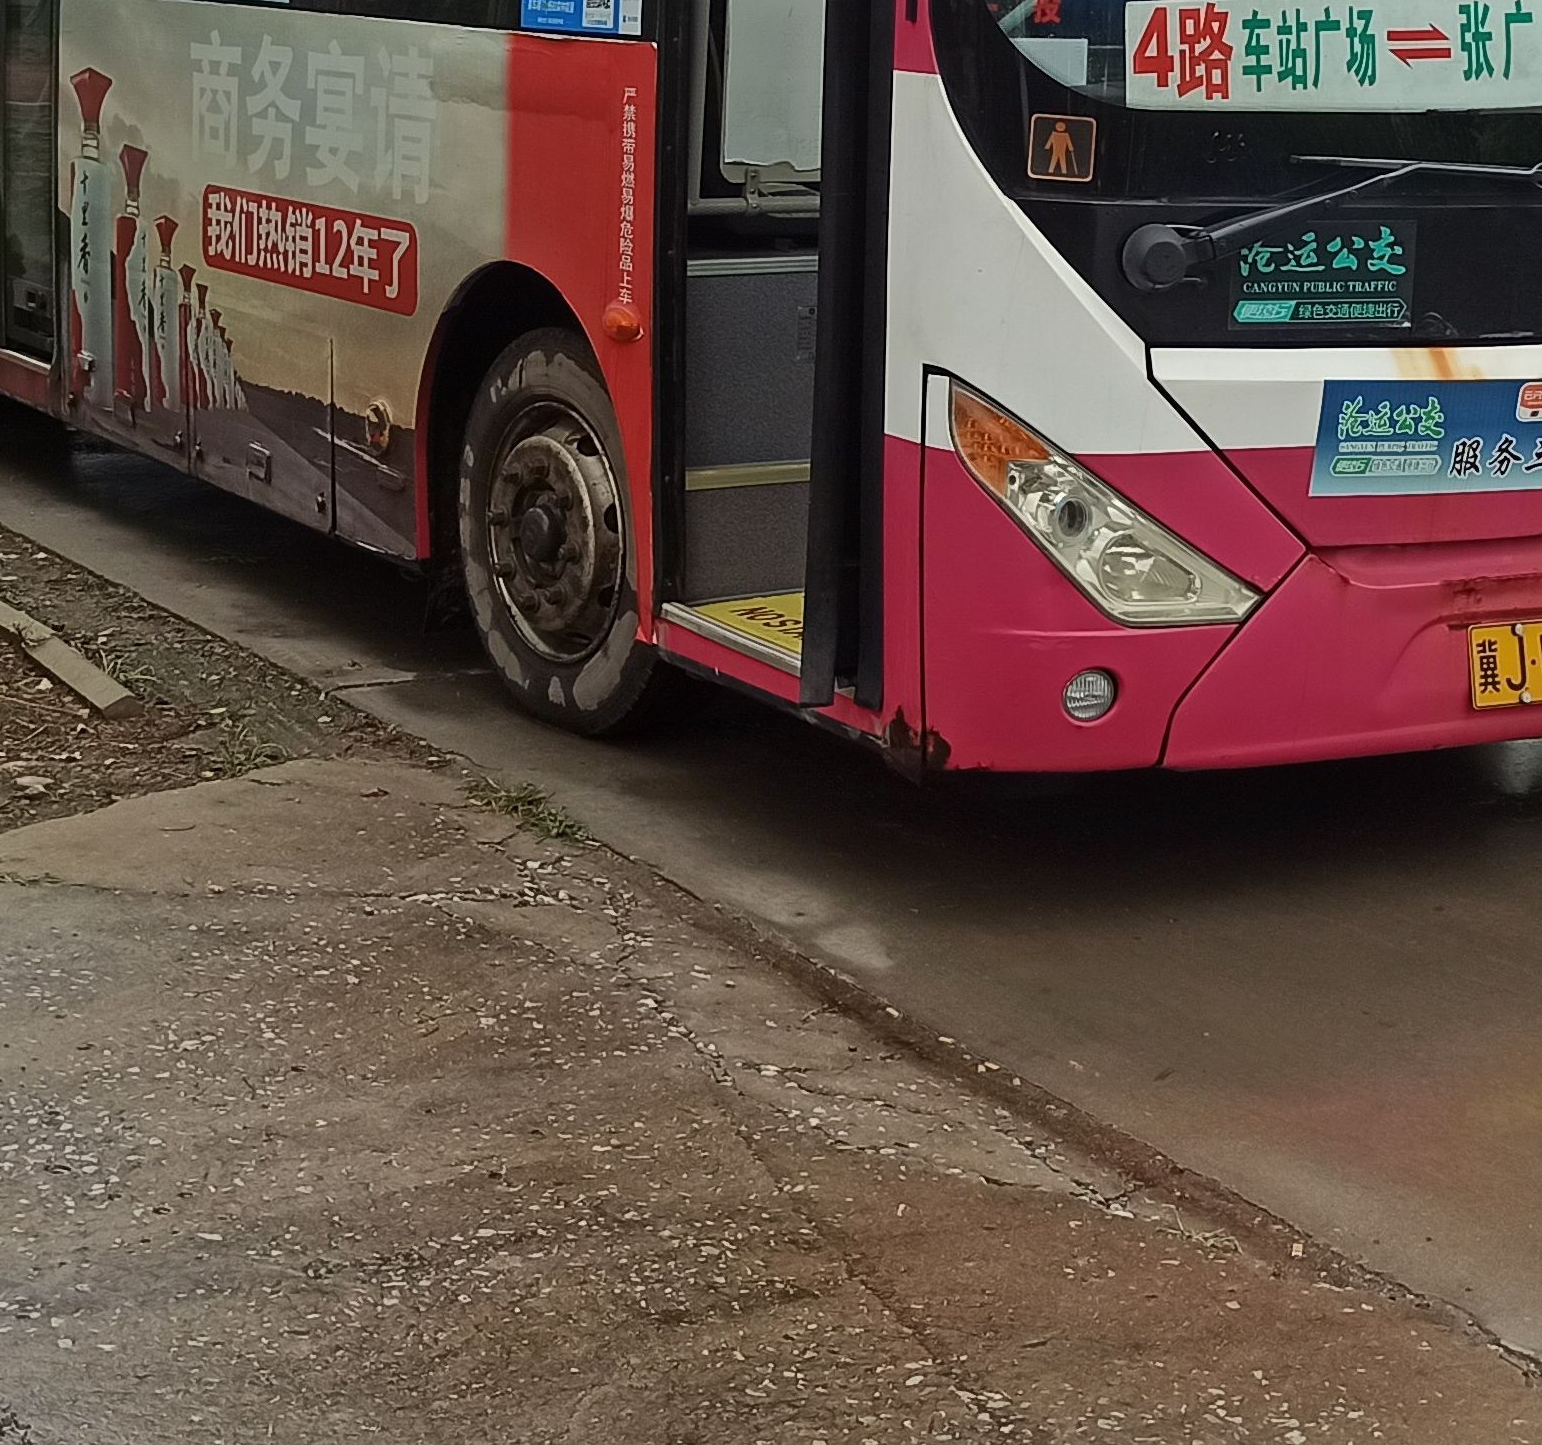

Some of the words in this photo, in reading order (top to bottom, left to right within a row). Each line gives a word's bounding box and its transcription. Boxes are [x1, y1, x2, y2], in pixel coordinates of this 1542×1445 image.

[1132, 2, 1234, 101] 4路
[1241, 5, 1378, 93] 车站广场
[190, 29, 438, 205] 商务宴请
[207, 191, 411, 299] 我们热销12年了
[1239, 225, 1408, 277] 沧运公交
[1242, 281, 1301, 293] CANGYUN
[1303, 281, 1346, 293] PUBLIC
[1347, 280, 1397, 292] TRAFFIC
